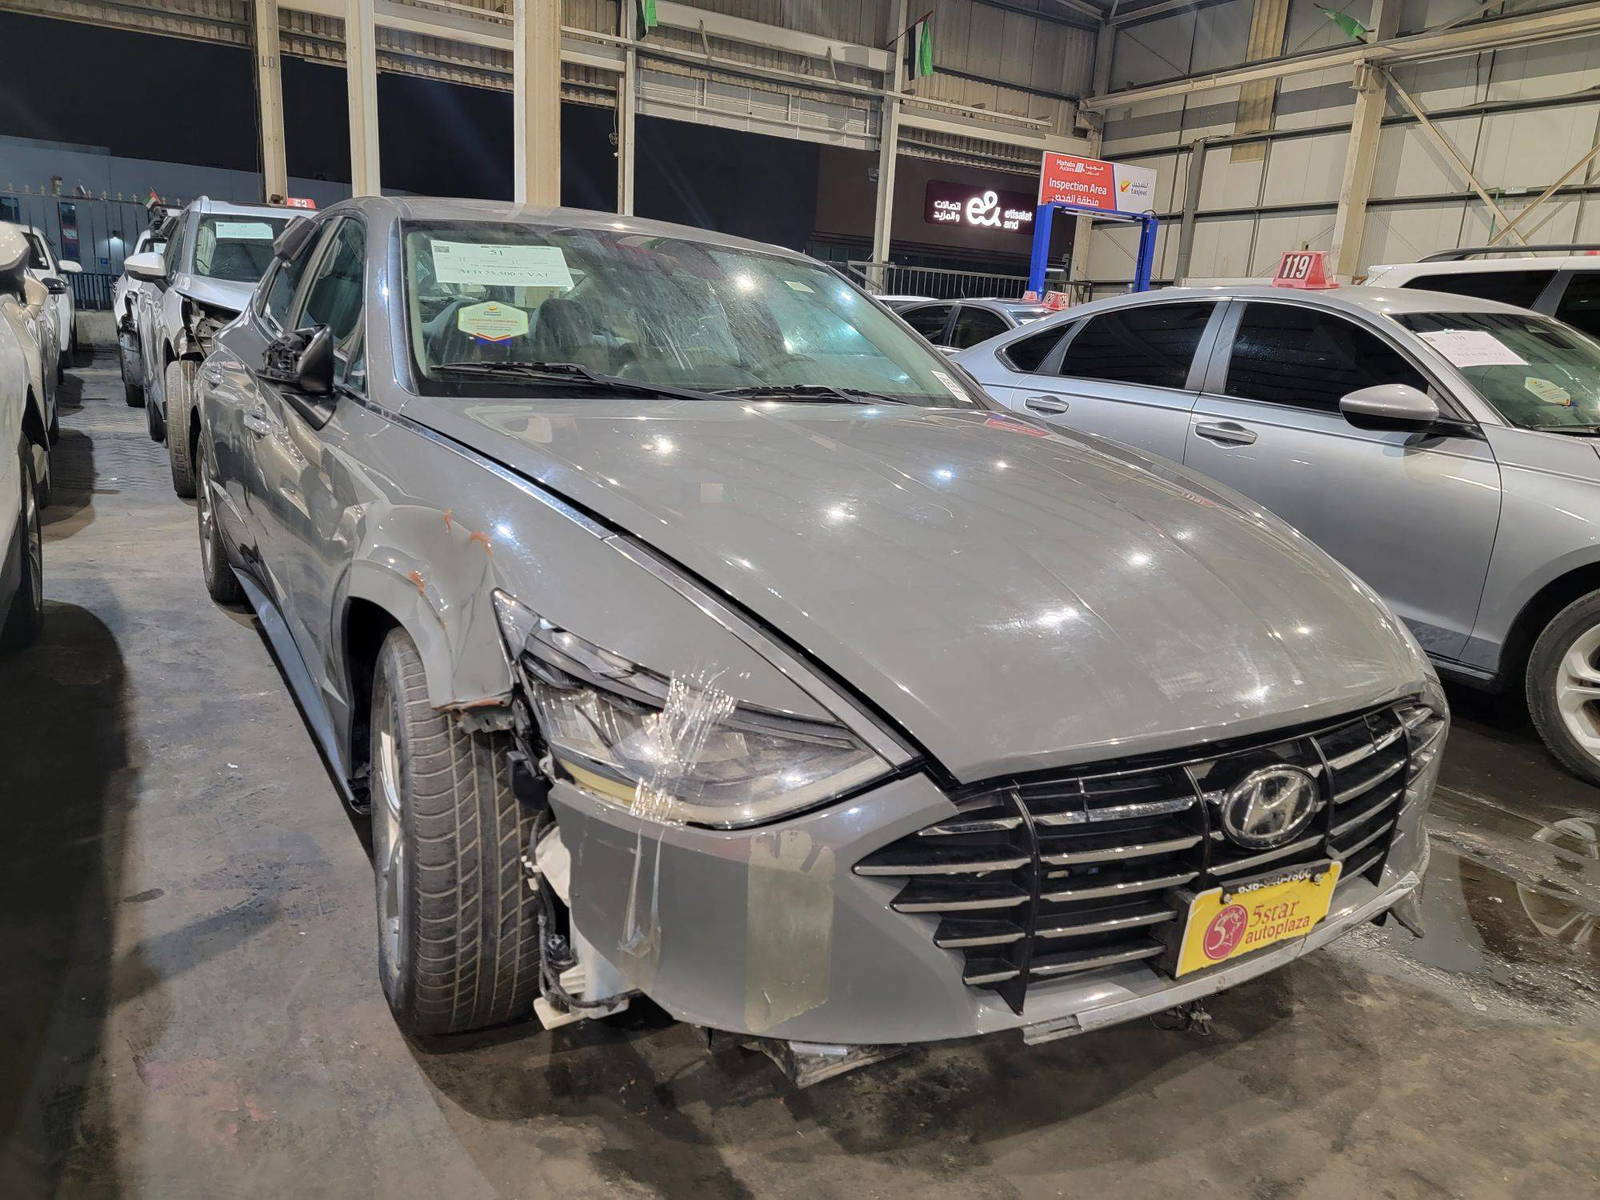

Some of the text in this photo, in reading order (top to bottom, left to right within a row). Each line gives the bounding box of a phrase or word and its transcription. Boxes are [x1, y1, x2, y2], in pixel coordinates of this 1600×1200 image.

[1049, 177, 1107, 195] Inspection Area
[934, 200, 962, 211] اتصالات
[1077, 195, 1099, 207] منطقة
[933, 210, 960, 222] والمزيد
[1004, 209, 1033, 221] etisalat
[1003, 220, 1019, 230] and
[1282, 255, 1310, 279] 119
[1249, 900, 1300, 928] 5star
[1245, 914, 1311, 945] autoplaza
